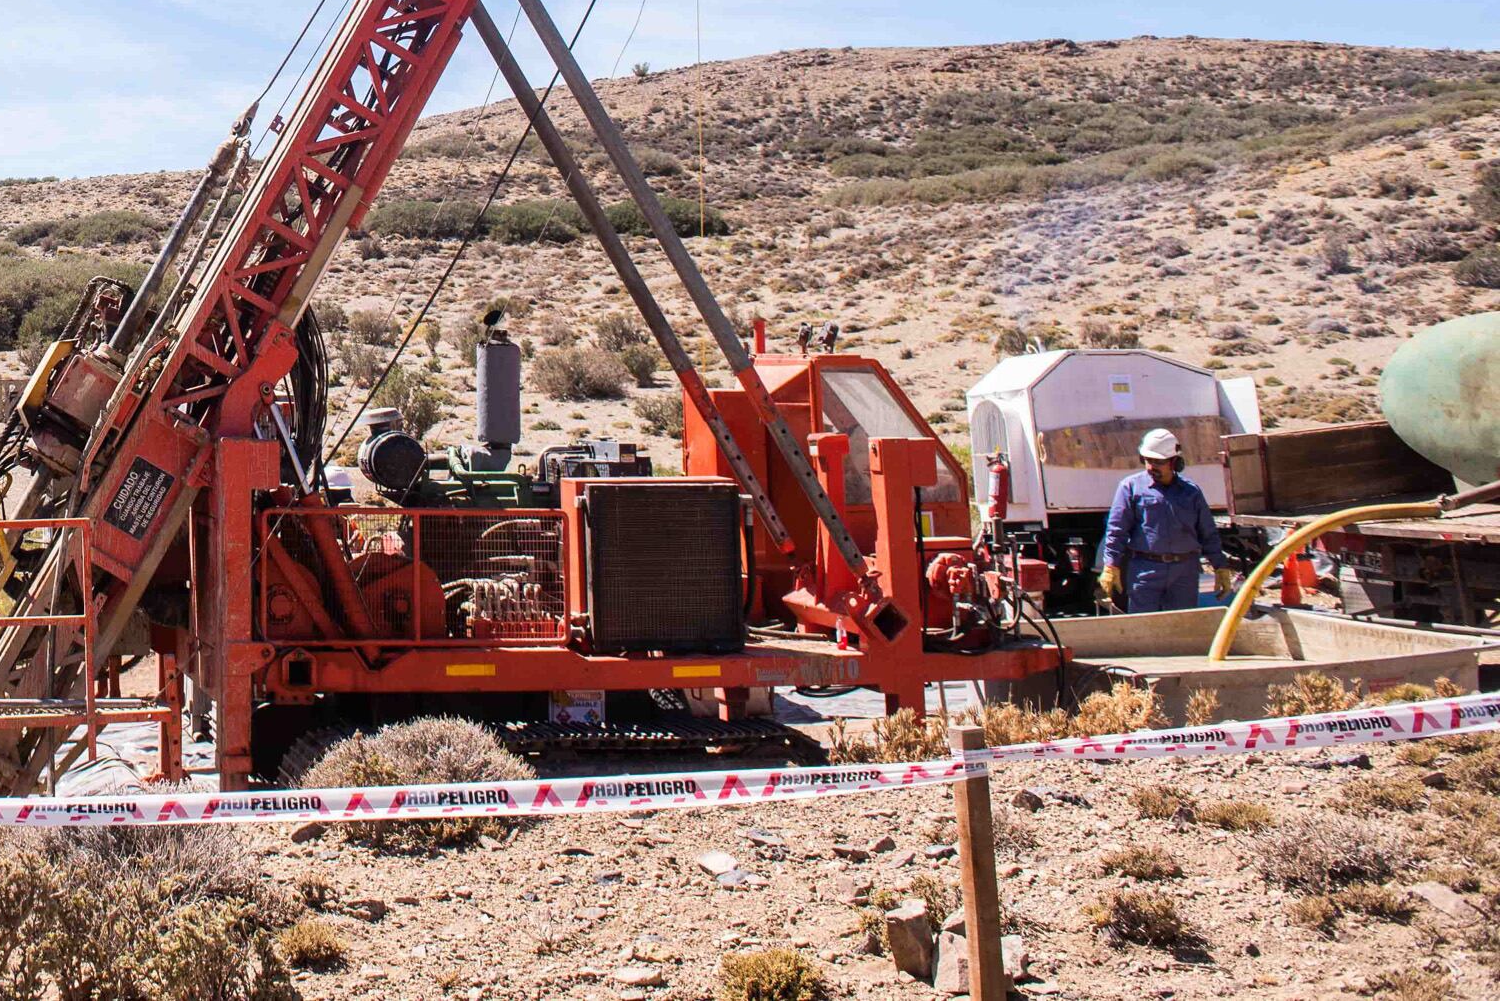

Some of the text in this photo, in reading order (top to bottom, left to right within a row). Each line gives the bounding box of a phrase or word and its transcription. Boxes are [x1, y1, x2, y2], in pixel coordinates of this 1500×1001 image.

[113, 472, 139, 510] CUIDADO
[120, 471, 151, 521] CUANDO TRABAJE
[129, 472, 167, 535] MASTIL USE CINTURON
[132, 484, 152, 516] ARRIBA DEL
[141, 486, 167, 529] DE SEGURIDAD
[1161, 731, 1226, 745] PELIGRO
[1329, 716, 1392, 733] PELIGRO
[66, 802, 137, 814] PELIGRO
[251, 796, 322, 811] PELIGRO
[438, 789, 509, 805] PELIGRO
[624, 780, 697, 797] PELIGRO
[810, 771, 882, 786] PELIGRO
